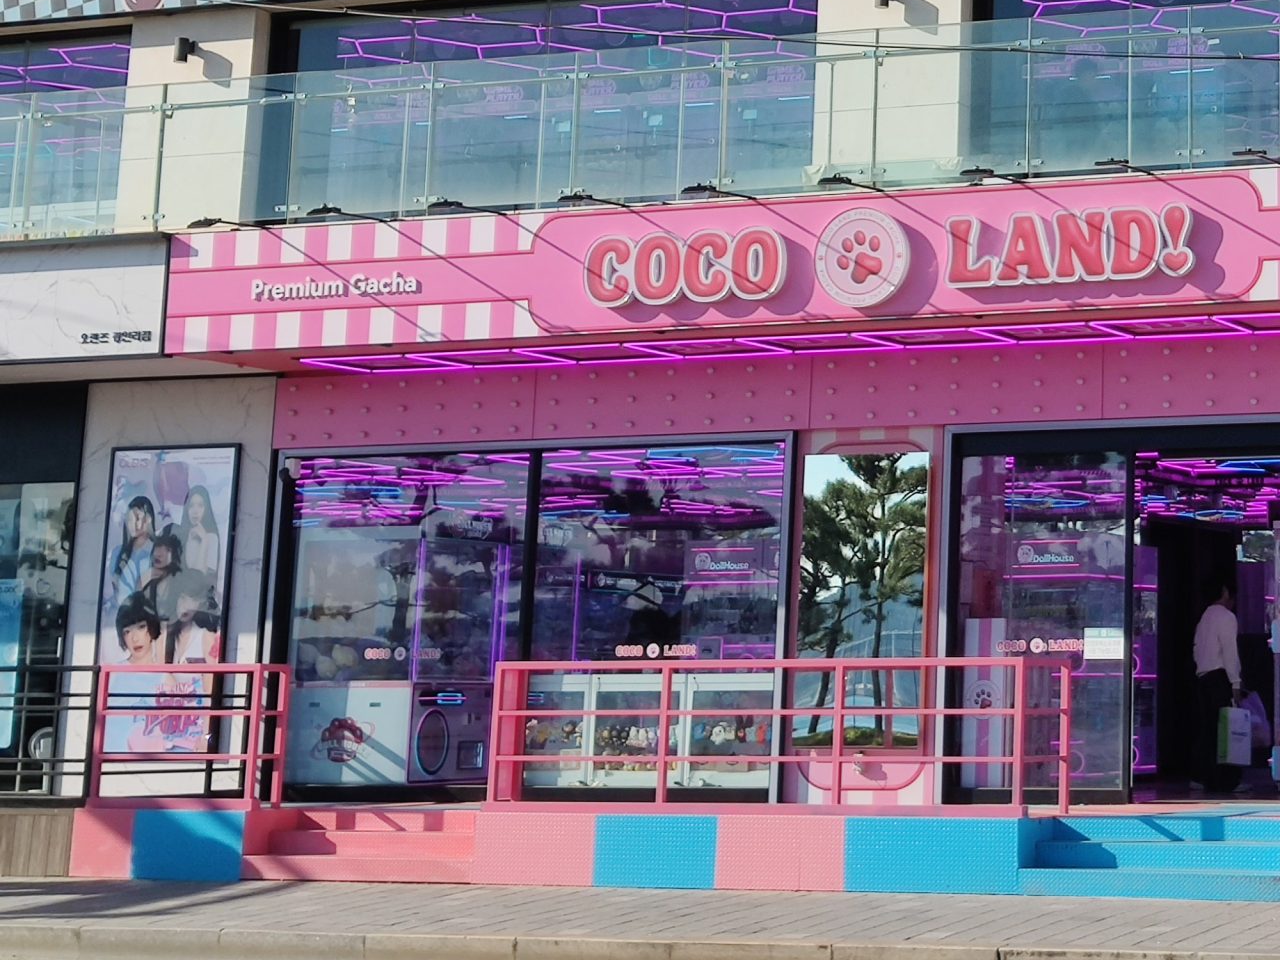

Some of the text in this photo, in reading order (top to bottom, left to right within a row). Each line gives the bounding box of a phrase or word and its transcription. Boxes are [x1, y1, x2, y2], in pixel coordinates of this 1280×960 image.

[251, 270, 419, 301] Premium Gacha
[584, 226, 787, 308] COCO
[945, 203, 1194, 288] LAND!
